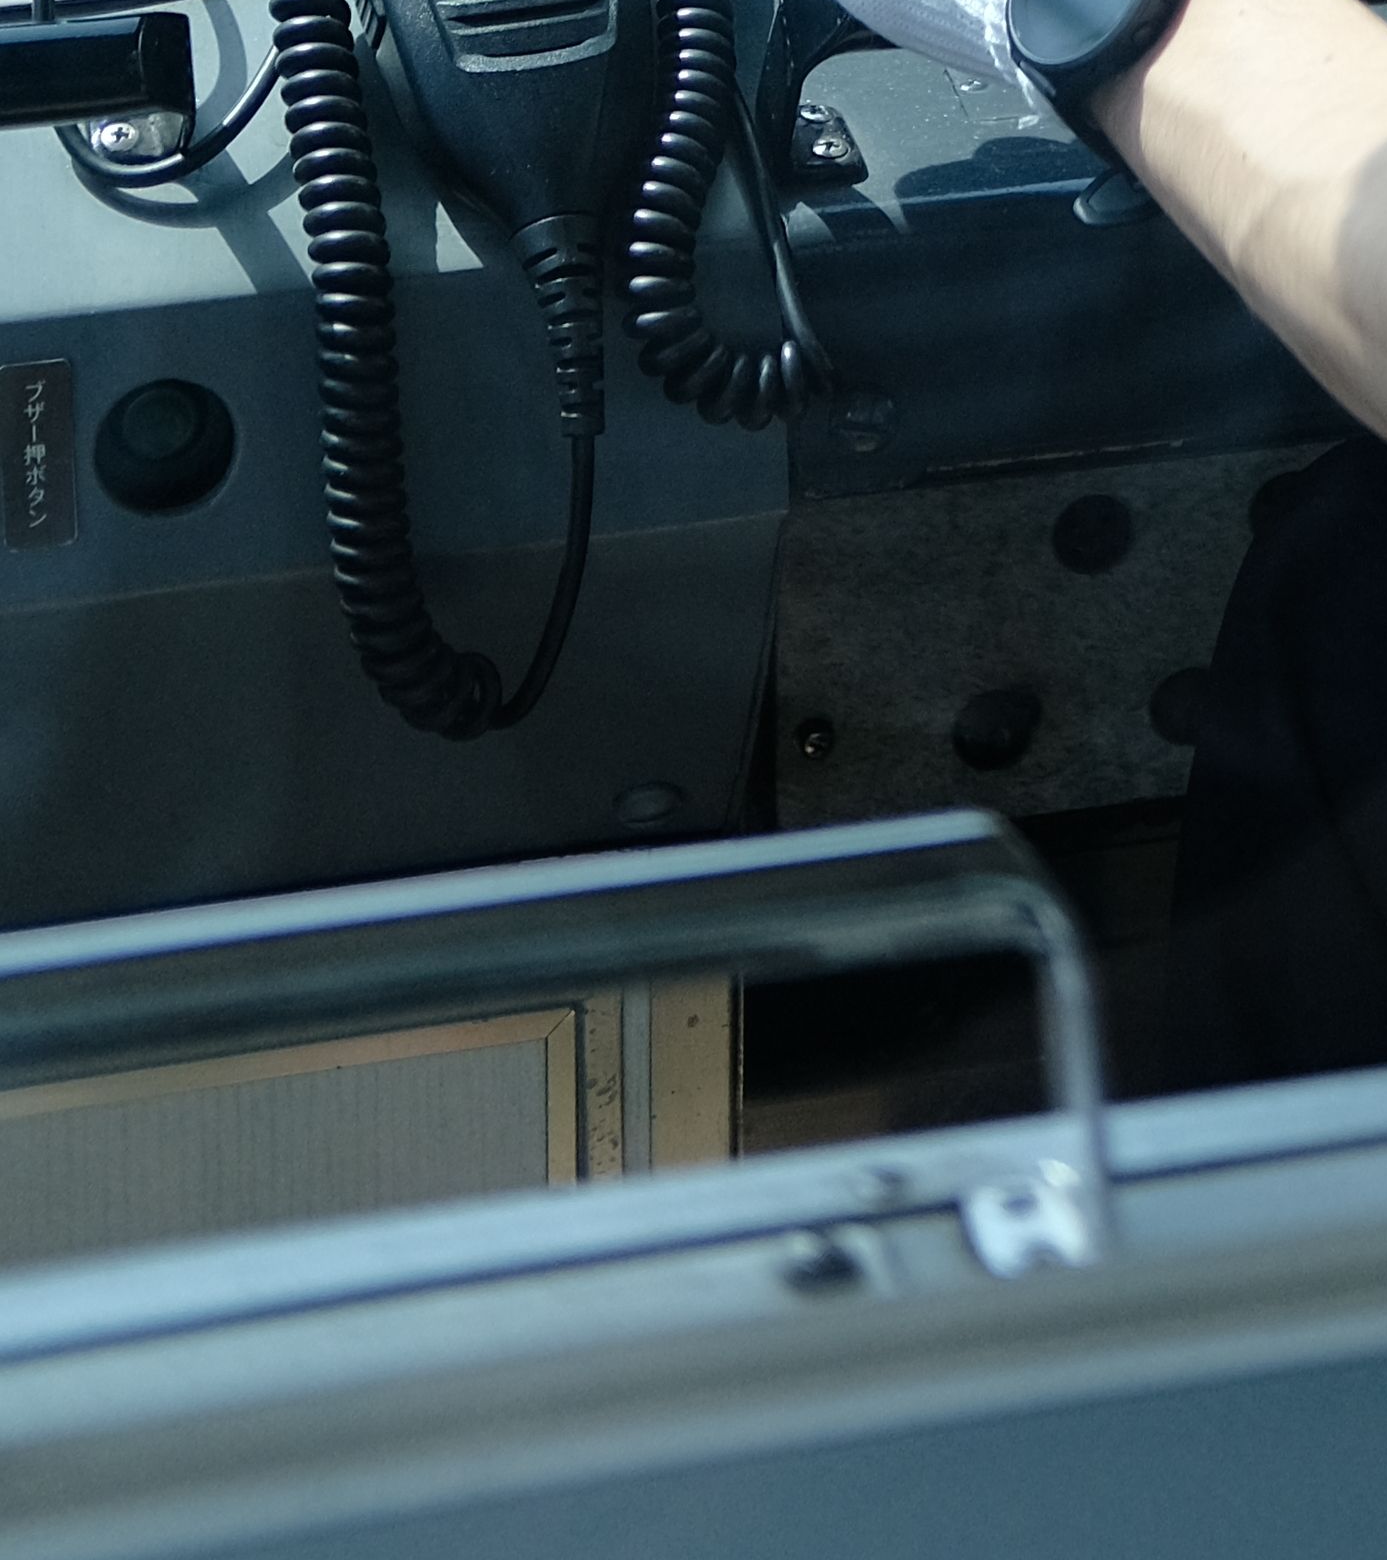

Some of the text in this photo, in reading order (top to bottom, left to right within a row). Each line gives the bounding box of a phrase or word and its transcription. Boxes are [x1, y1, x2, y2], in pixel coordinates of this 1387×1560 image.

[23, 379, 48, 528] ブザー押ボタン
